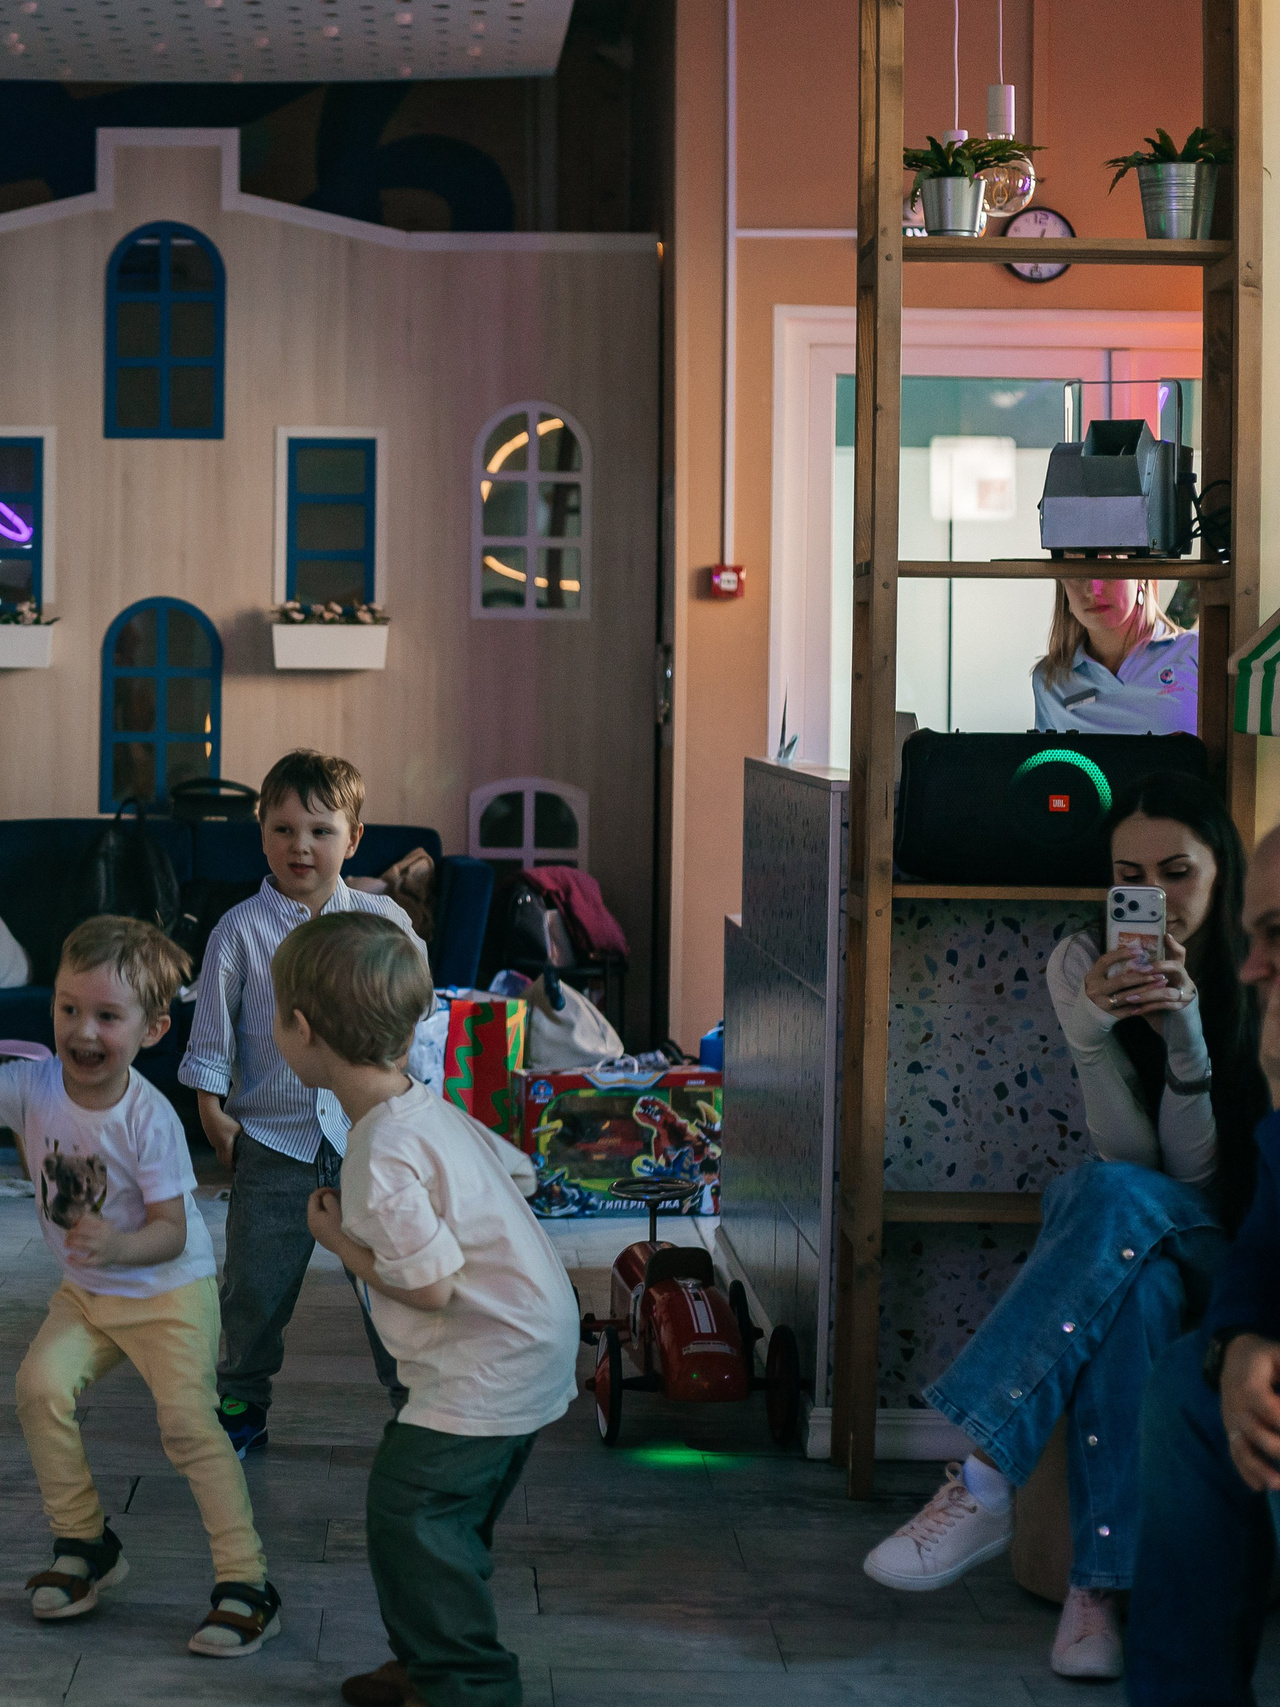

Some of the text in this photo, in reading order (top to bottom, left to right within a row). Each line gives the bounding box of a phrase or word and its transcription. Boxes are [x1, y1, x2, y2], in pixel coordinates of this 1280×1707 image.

[1034, 212, 1049, 226] 12
[1052, 799, 1066, 808] JBL
[598, 1199, 680, 1210] ГИПЕРПКА
